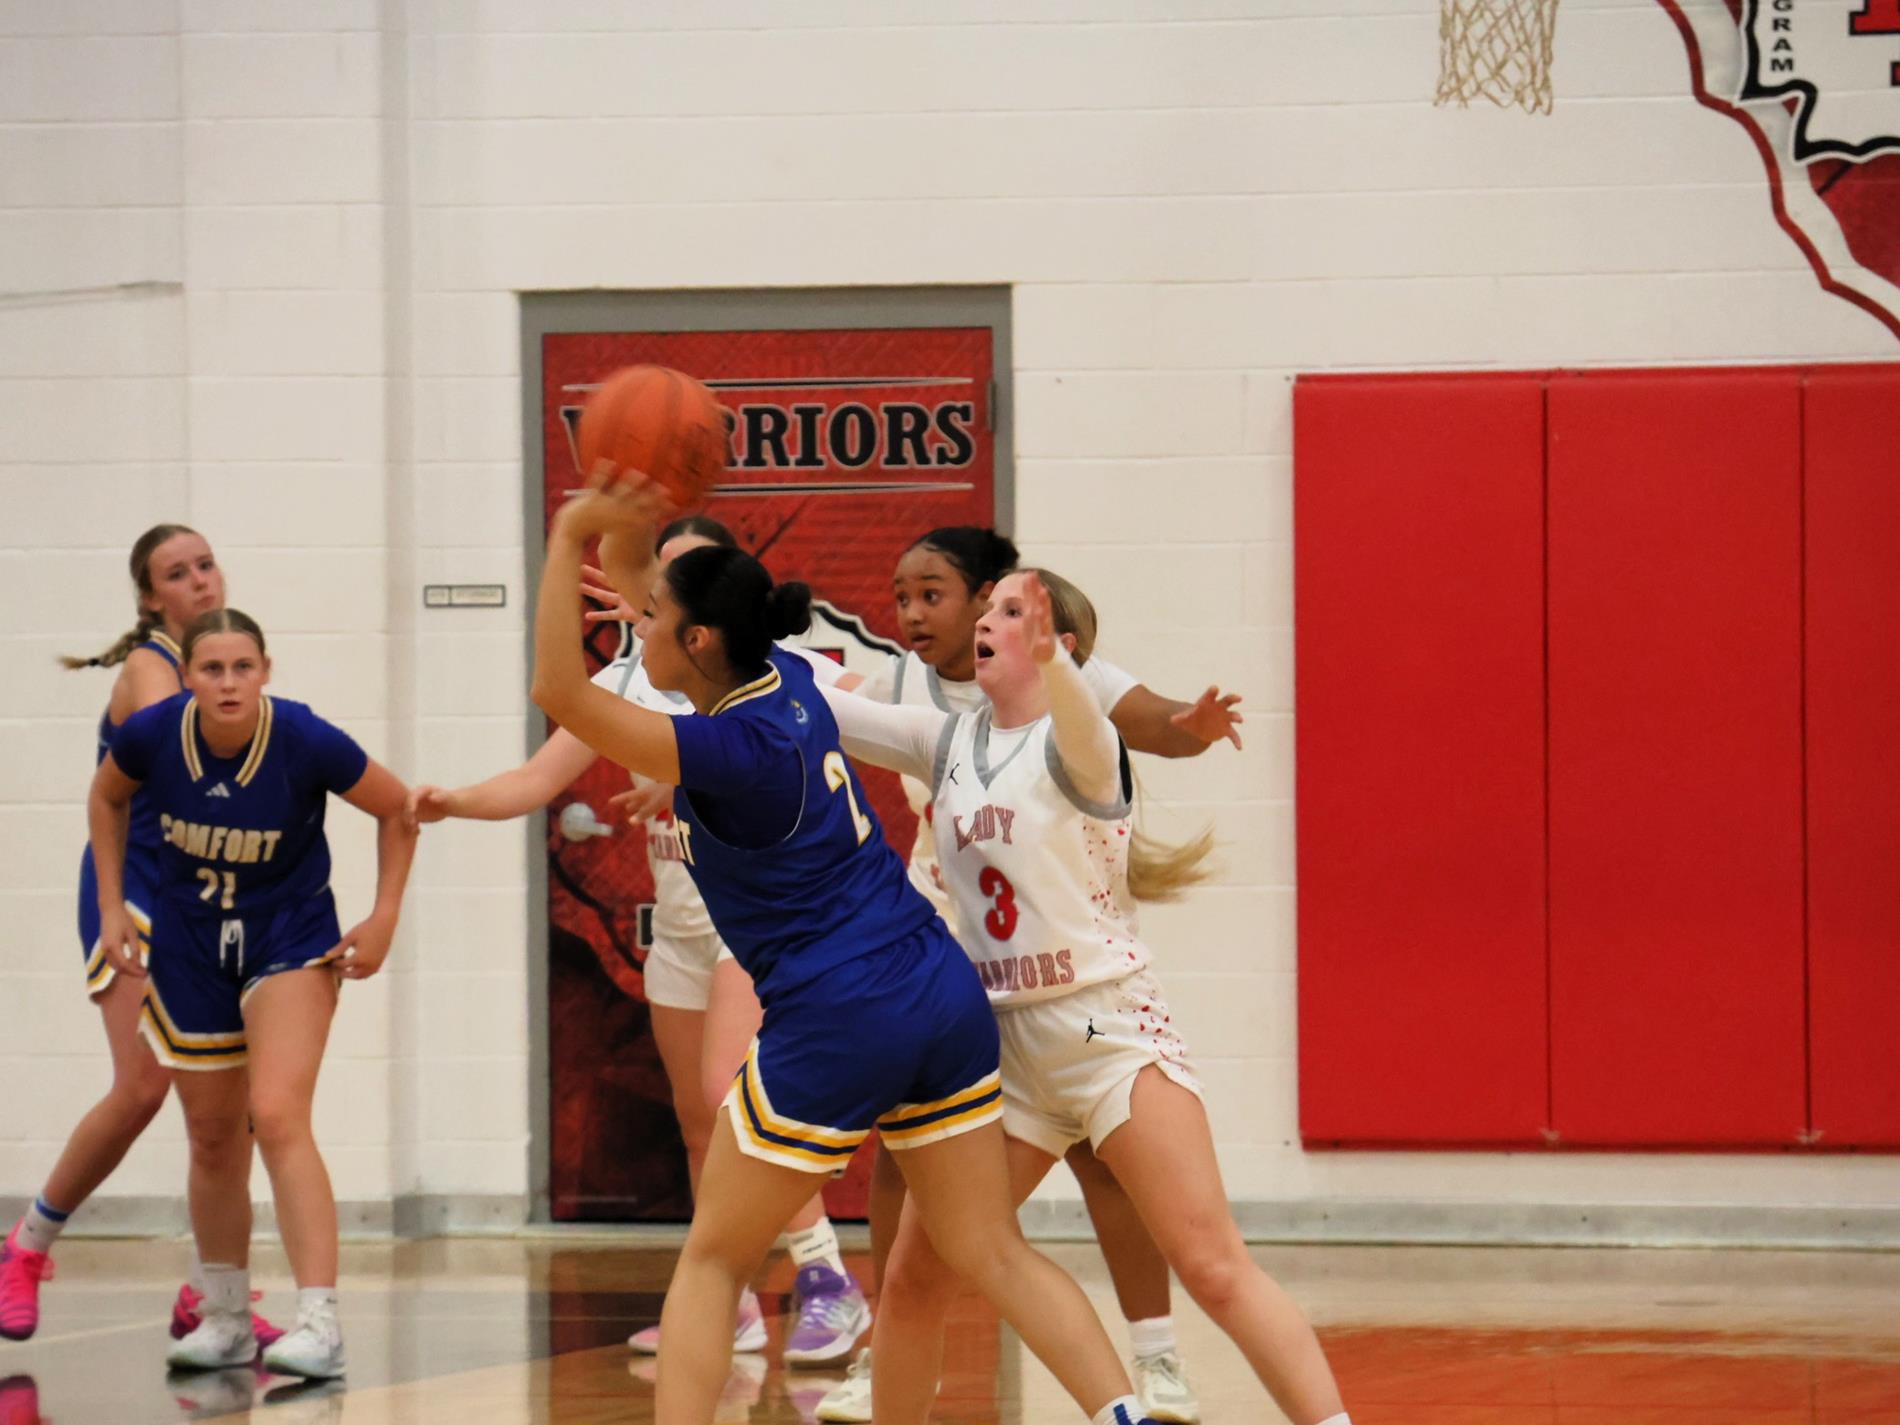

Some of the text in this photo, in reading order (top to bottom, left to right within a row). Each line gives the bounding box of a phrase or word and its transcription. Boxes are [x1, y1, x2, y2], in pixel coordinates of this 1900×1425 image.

[160, 813, 282, 864] COMFORT
[953, 804, 1015, 853] LADY
[196, 867, 237, 910] 21
[978, 865, 1020, 942] 3
